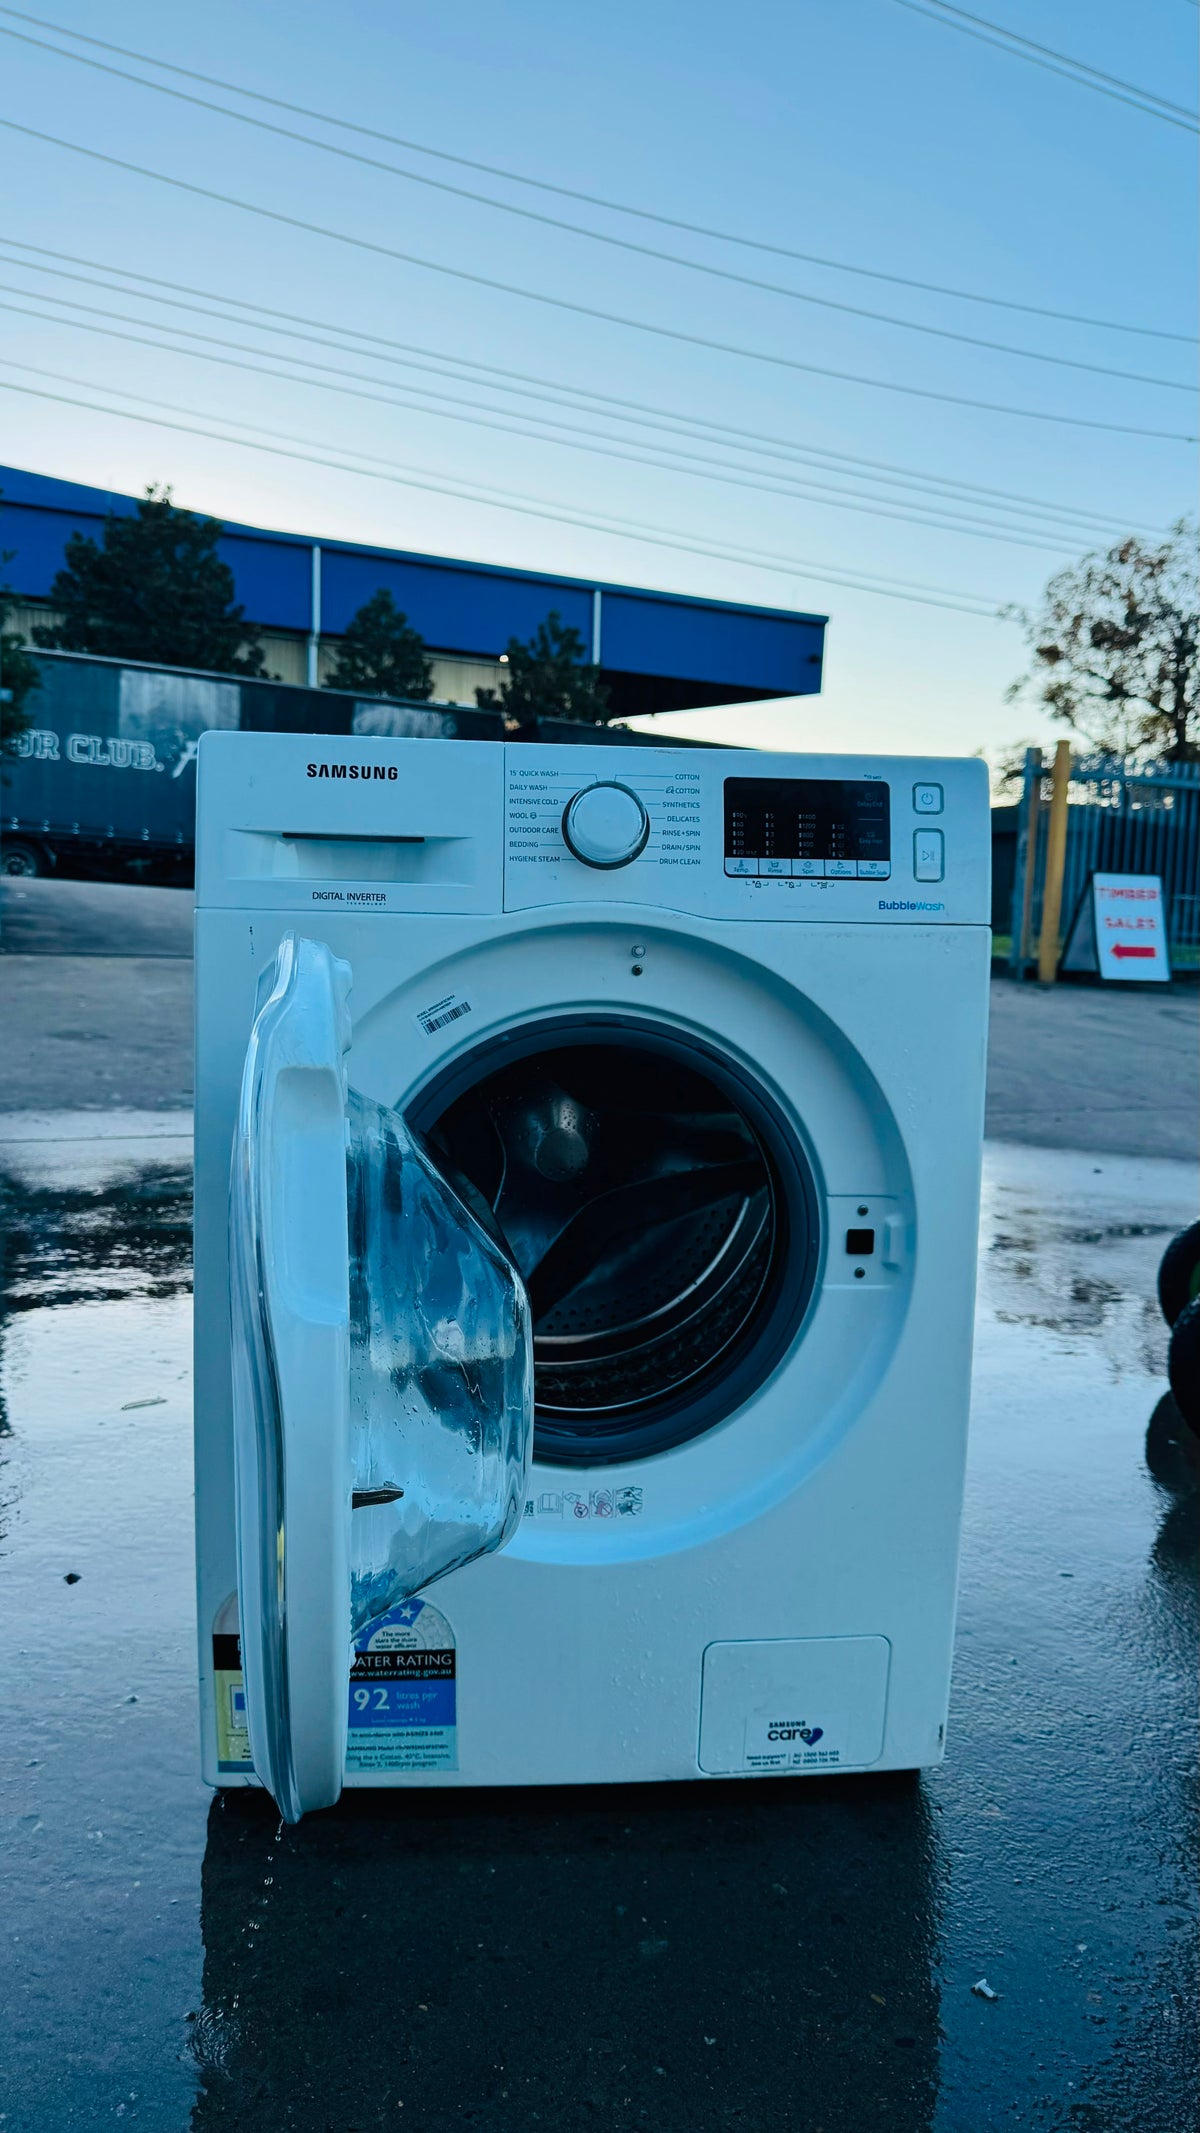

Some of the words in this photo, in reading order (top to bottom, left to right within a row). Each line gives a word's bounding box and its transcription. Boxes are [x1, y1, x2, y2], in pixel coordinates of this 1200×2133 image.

[67, 733, 165, 772] CLUB.
[306, 764, 398, 780] SAMSUNG
[662, 801, 700, 809] SYNTHETICS
[509, 826, 541, 834] OUTDOOR
[312, 891, 345, 900] DIGITAL
[346, 892, 386, 902] INVERTER
[878, 900, 945, 911] BubbleWash
[1104, 918, 1156, 930] SALES
[355, 1656, 391, 1668] ATER
[396, 1654, 452, 1666] RATING
[354, 1688, 390, 1711] 92
[396, 1692, 419, 1700] litres
[422, 1692, 438, 1701] per
[769, 1720, 806, 1728] SAMSUNG
[768, 1728, 812, 1741] care
